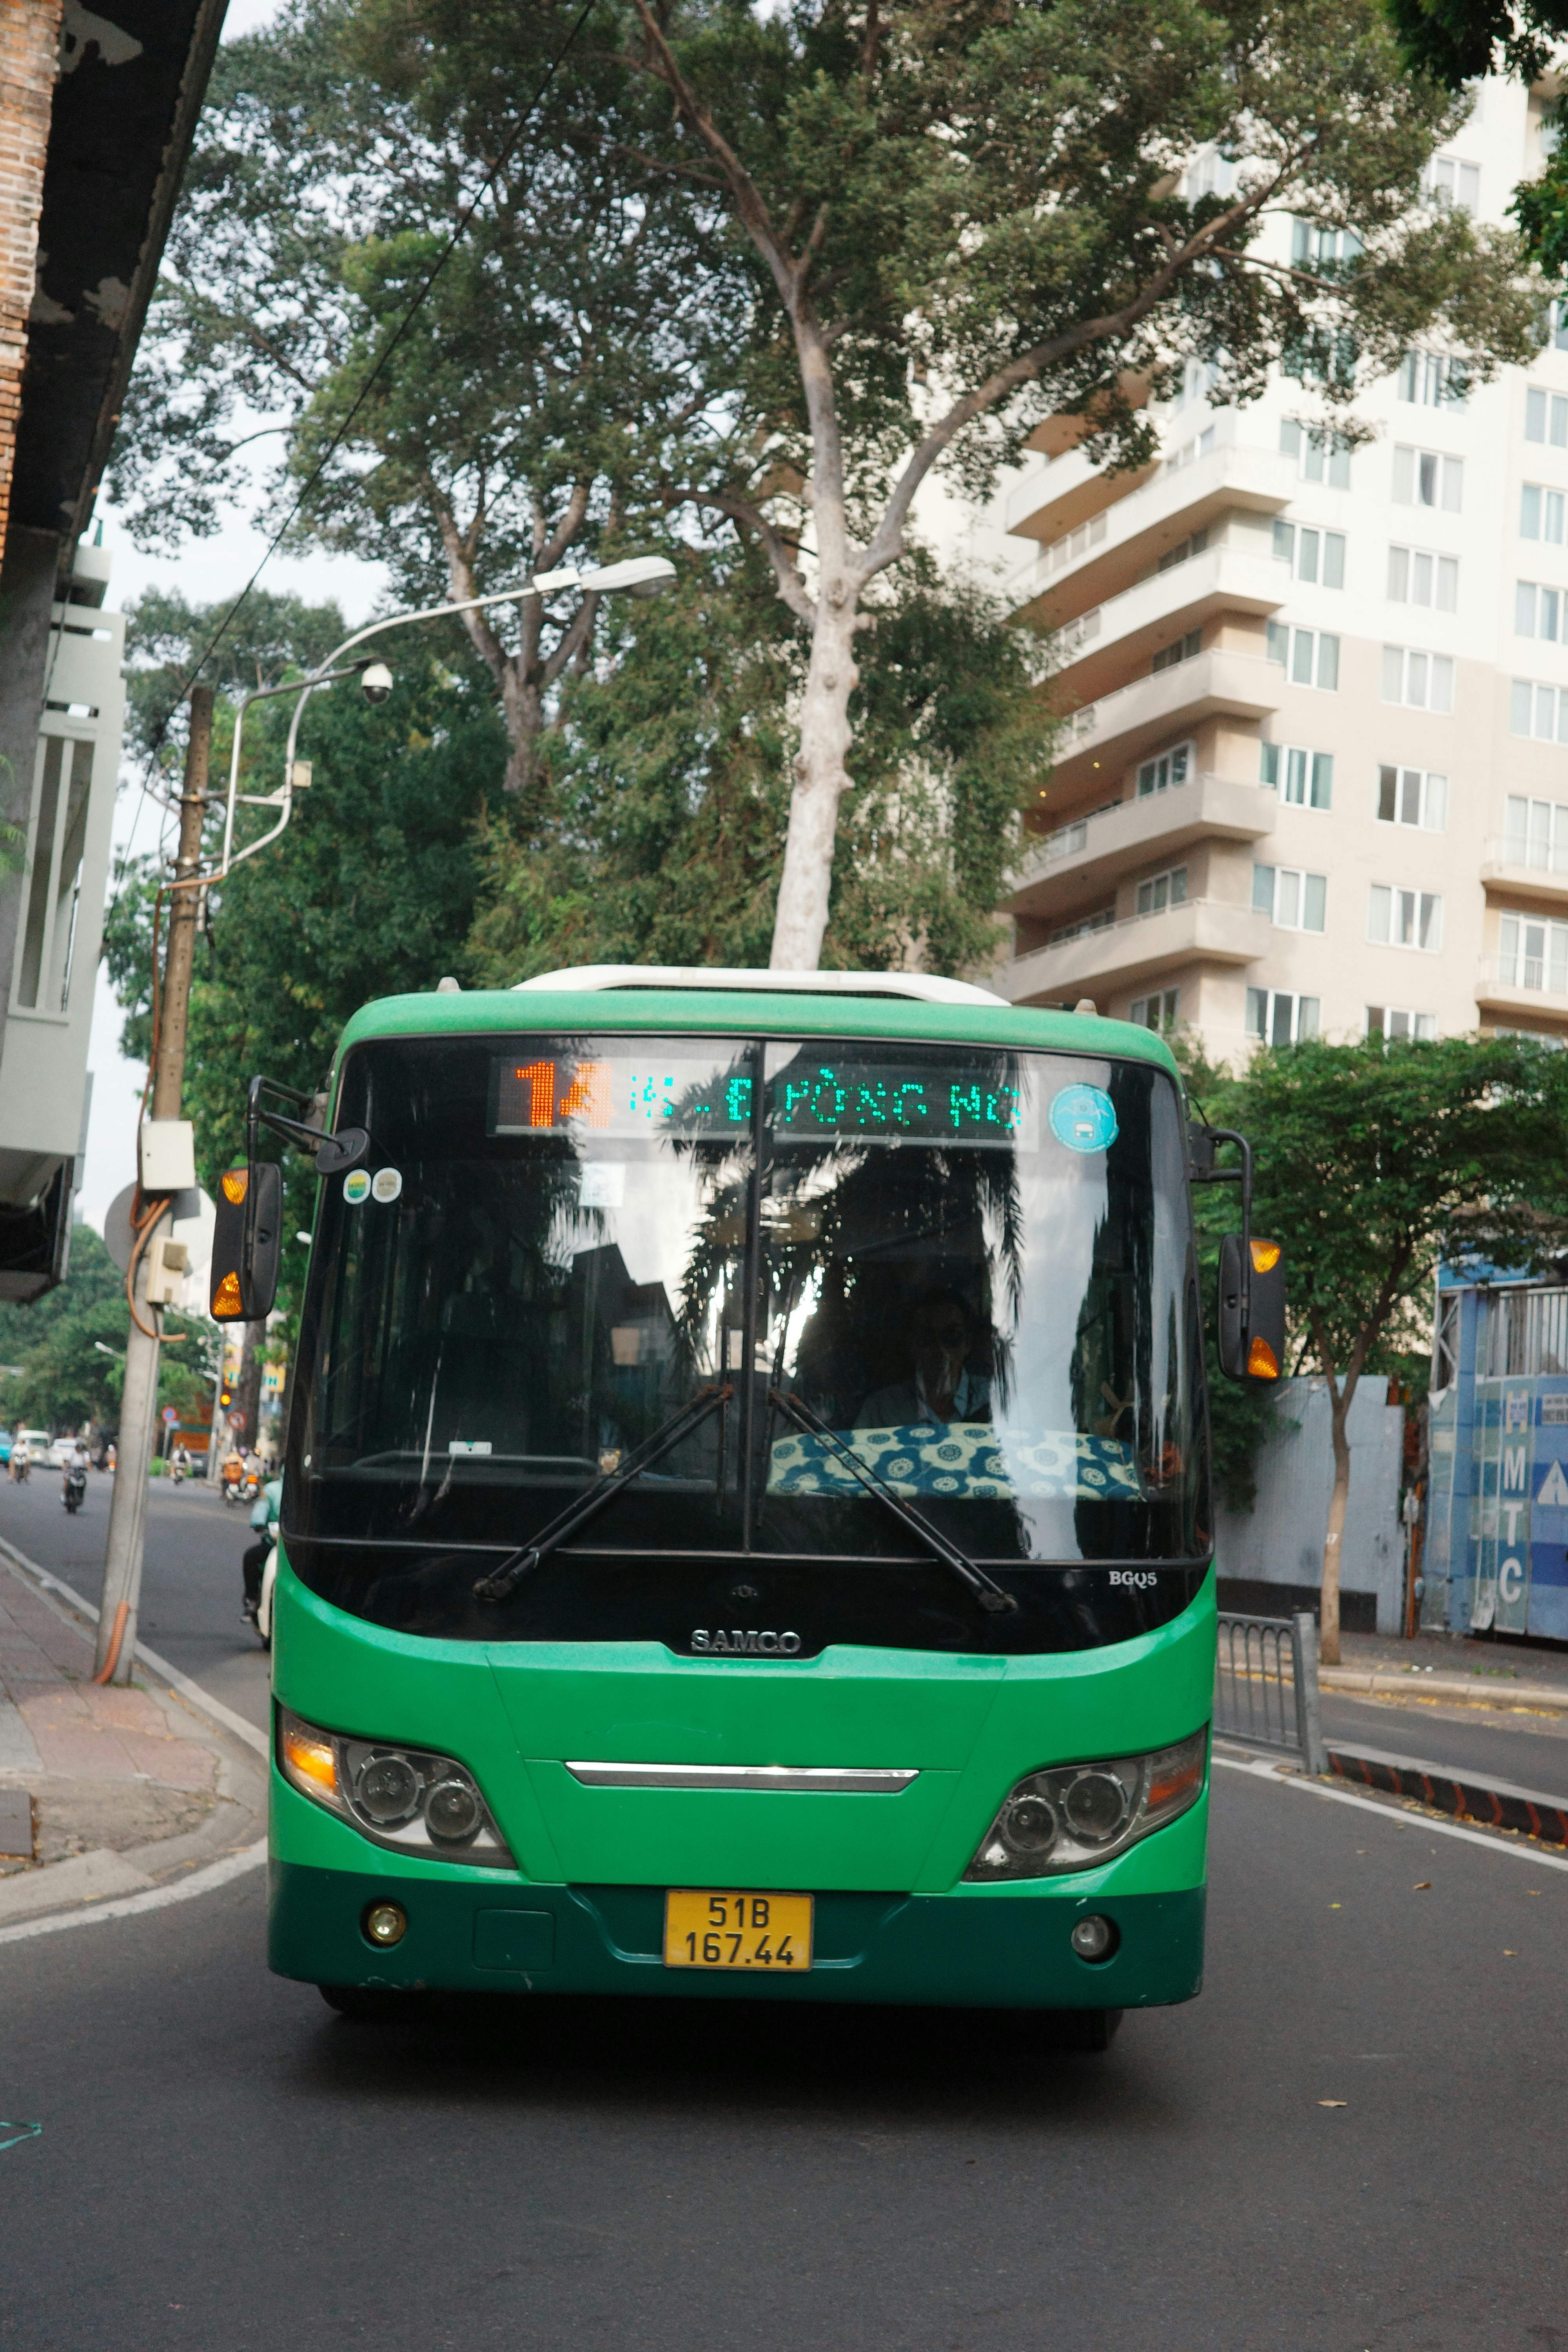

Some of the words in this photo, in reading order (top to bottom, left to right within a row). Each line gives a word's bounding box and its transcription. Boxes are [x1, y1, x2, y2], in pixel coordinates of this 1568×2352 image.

[1109, 1571, 1158, 1589] BGQ5
[691, 1629, 801, 1653] SAMCO
[709, 1896, 769, 1928] 51B
[686, 1932, 794, 1965] 167.44
